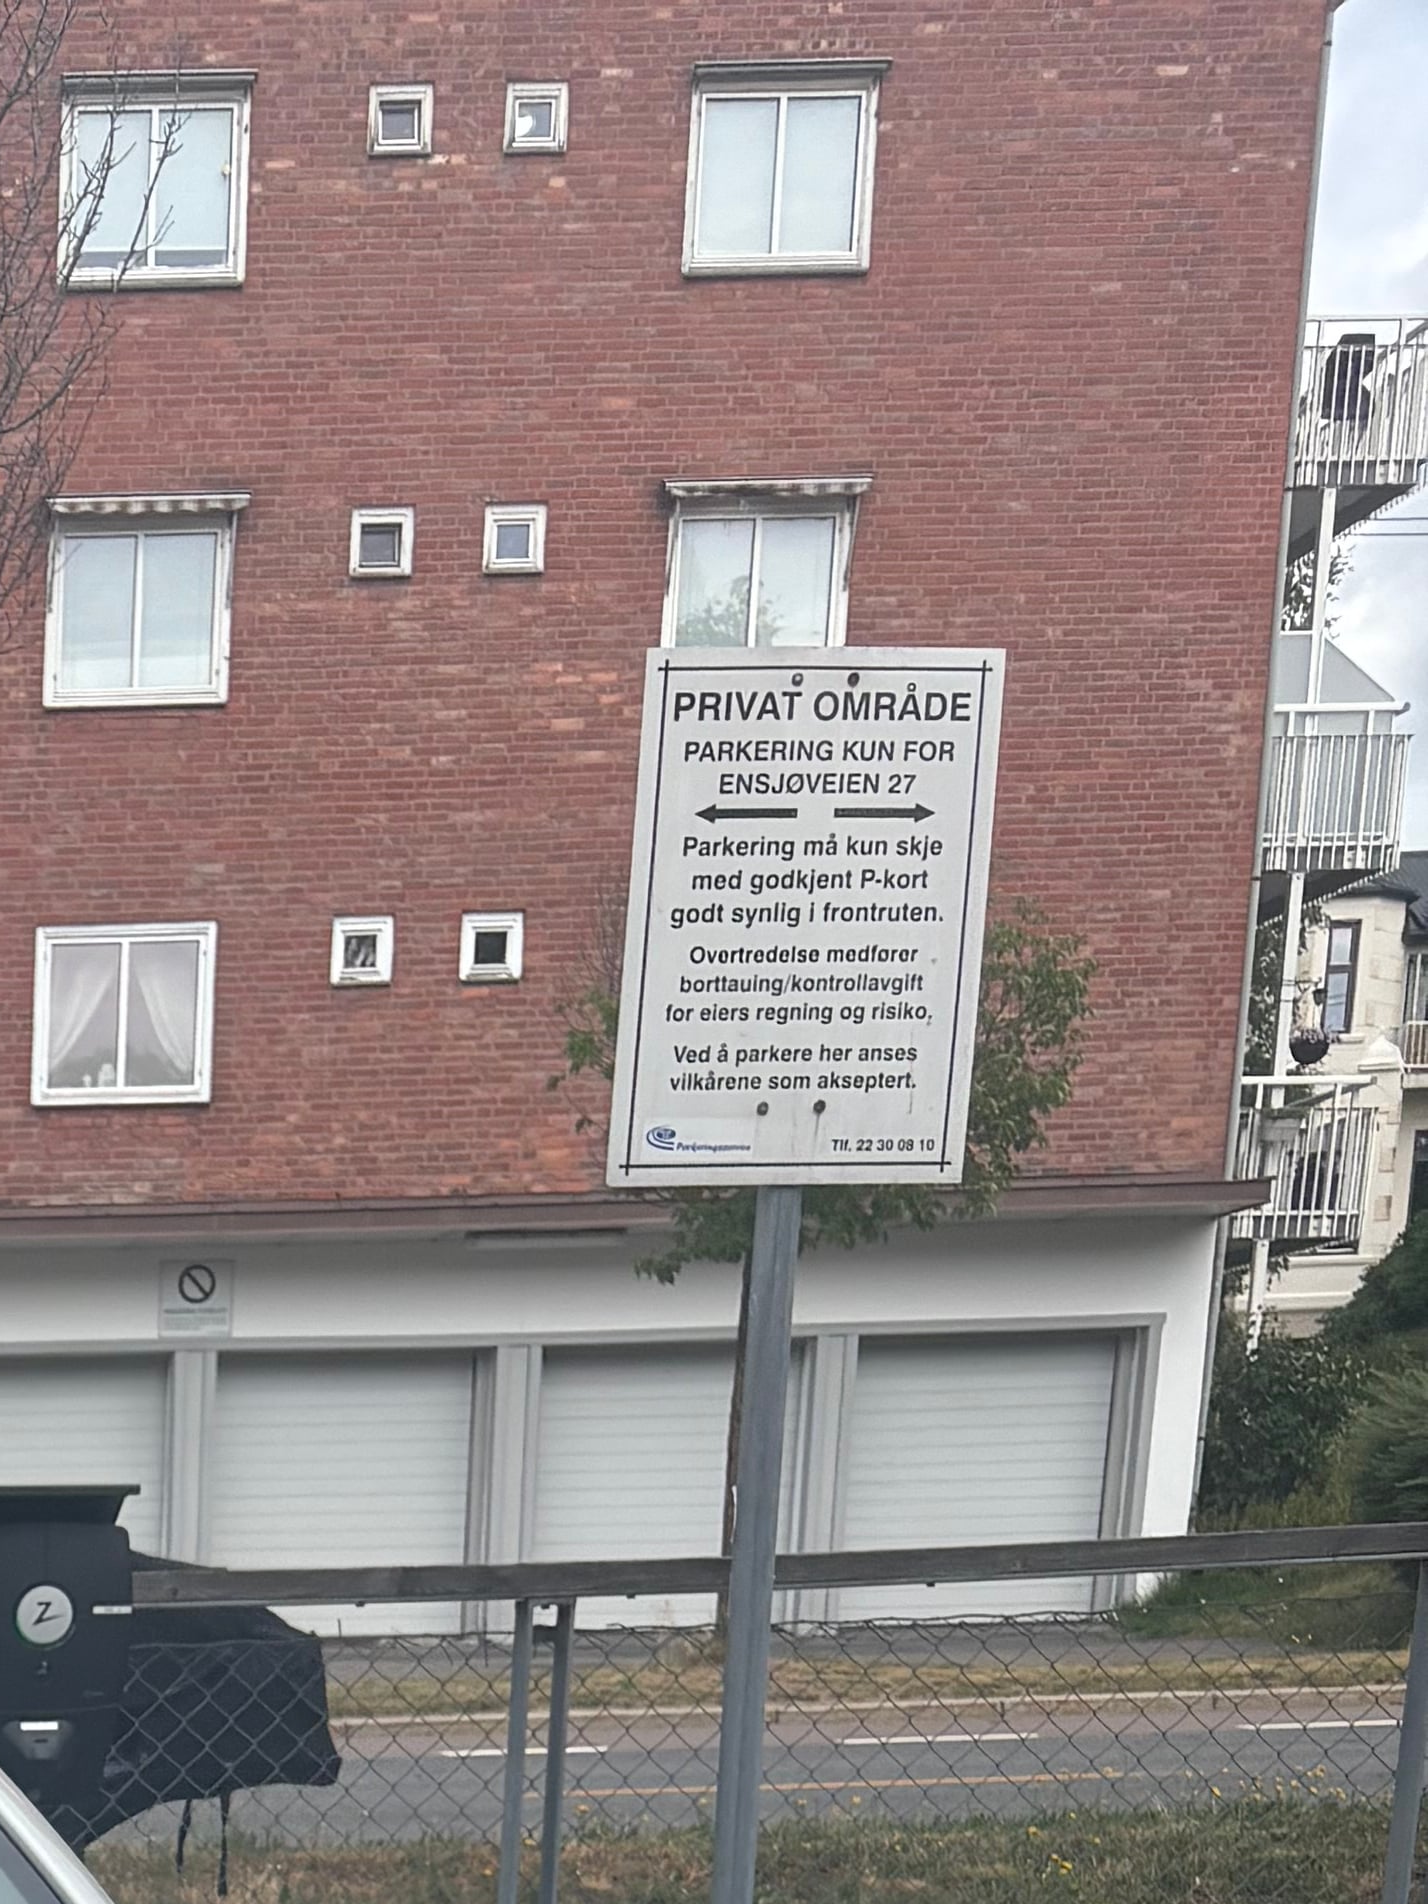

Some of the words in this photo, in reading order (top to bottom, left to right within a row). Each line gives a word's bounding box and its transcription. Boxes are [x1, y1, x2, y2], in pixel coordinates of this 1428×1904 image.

[673, 691, 803, 722] PRIVAT
[813, 682, 972, 722] OMRÅDE
[684, 740, 834, 763] PARKERING
[842, 740, 895, 762] KUN
[903, 740, 955, 762] FOR
[719, 772, 880, 795] ENSJØVEIEN
[887, 773, 917, 795] 27
[682, 835, 795, 862] Parkering
[803, 832, 838, 857] må
[846, 835, 888, 856] kun
[895, 835, 943, 861] skje
[691, 869, 743, 891] med
[750, 868, 852, 896] godkjent
[860, 868, 929, 890] P-kort
[670, 903, 724, 929] godt
[731, 902, 801, 929] synlig
[809, 901, 815, 923] i
[823, 901, 944, 923] frontruten.
[689, 945, 820, 965] Overtredelse
[826, 944, 919, 963] medfører
[679, 973, 924, 997] borttauing/kontrollavgift
[666, 1003, 695, 1022] for
[699, 1003, 750, 1022] eiers
[756, 1002, 833, 1025] regning
[839, 1006, 865, 1025] og
[673, 1045, 711, 1064] Ved
[716, 1042, 729, 1063] å
[735, 1044, 813, 1068] parkere
[819, 1043, 853, 1062] her
[858, 1047, 918, 1062] anses
[670, 1070, 762, 1091] vilkårene
[768, 1075, 811, 1090] som
[817, 1071, 916, 1094] akseptert.
[831, 1138, 852, 1152] Tlf.
[855, 1138, 873, 1152] 22
[876, 1138, 894, 1152] 30
[897, 1138, 915, 1152] 08
[919, 1138, 935, 1152] 10
